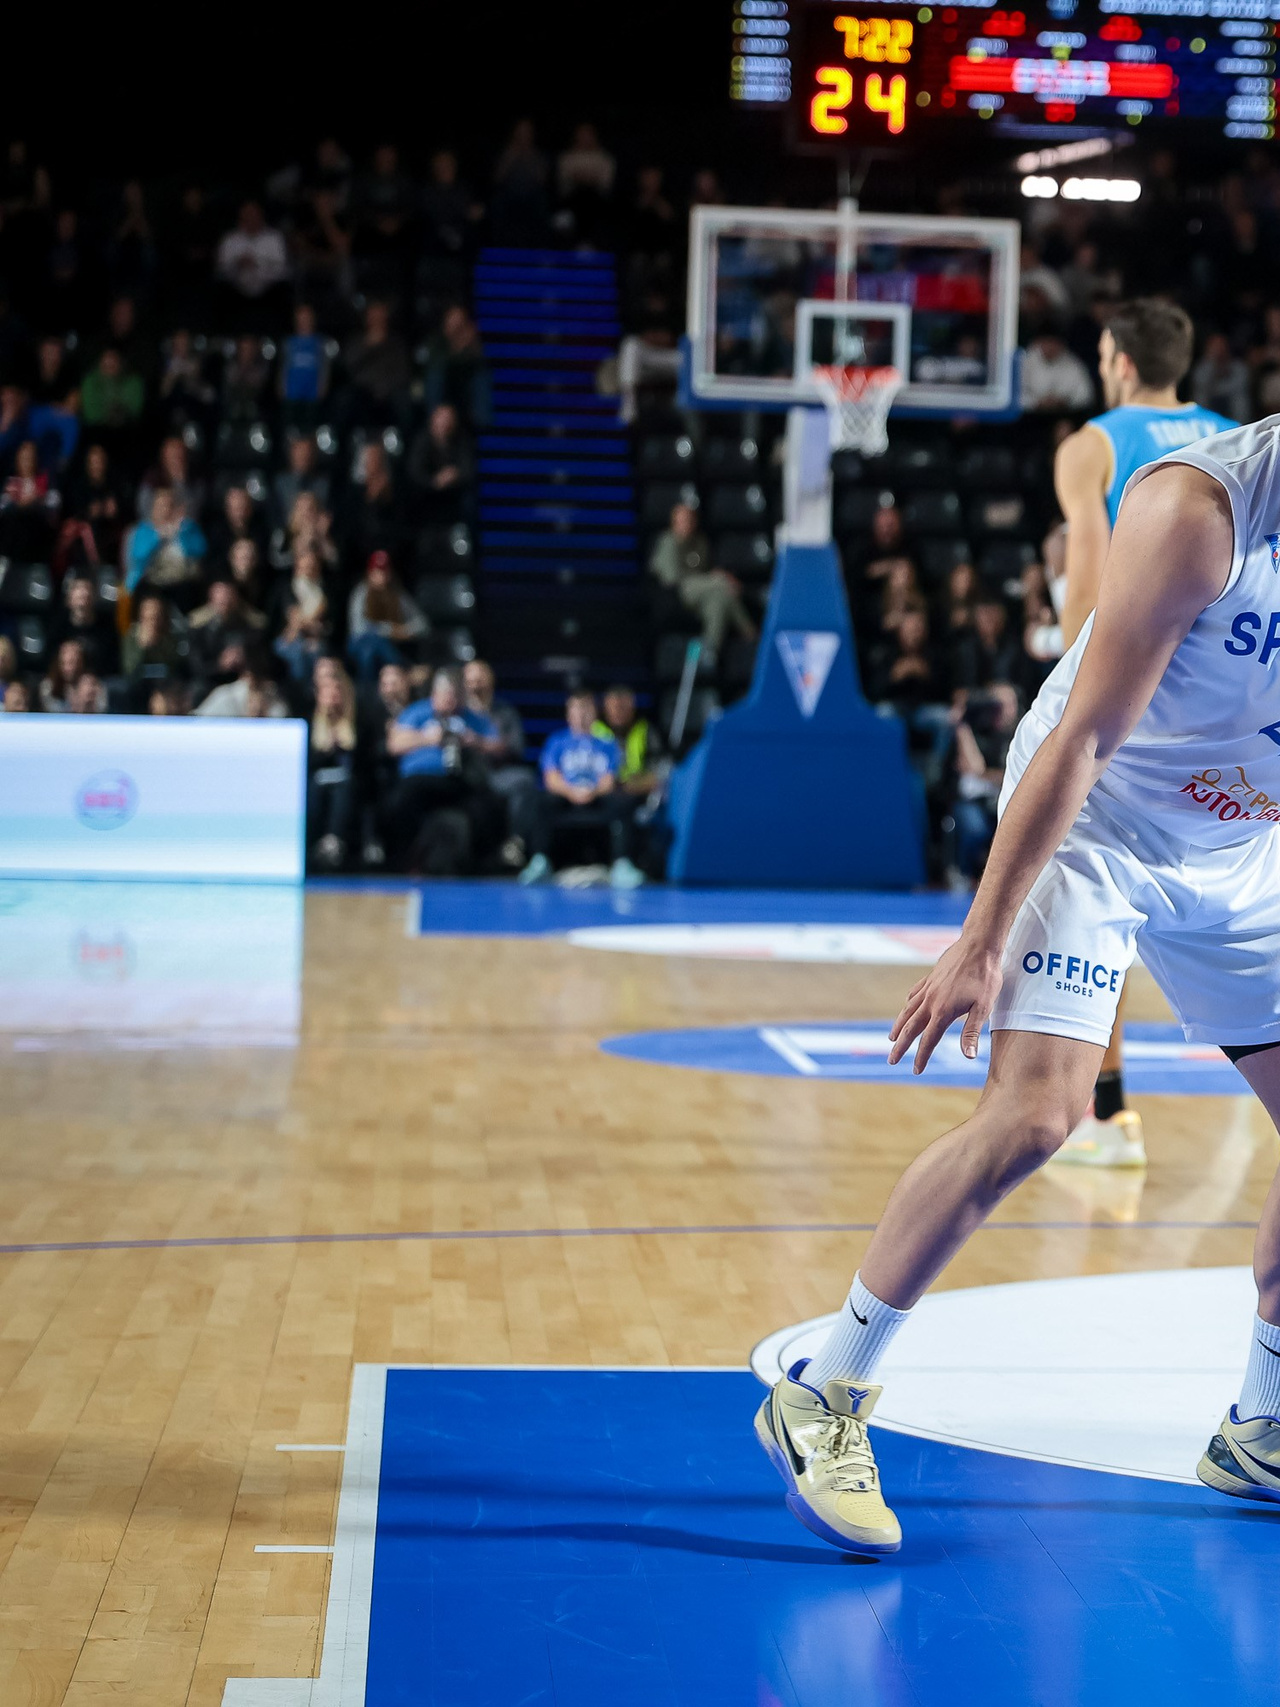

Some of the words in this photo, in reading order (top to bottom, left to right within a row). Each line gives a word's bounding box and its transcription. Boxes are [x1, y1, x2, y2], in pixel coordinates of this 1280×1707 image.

[811, 66, 906, 134] 24
[1022, 950, 1120, 993] OFFICE
[1055, 980, 1094, 998] SHOES
